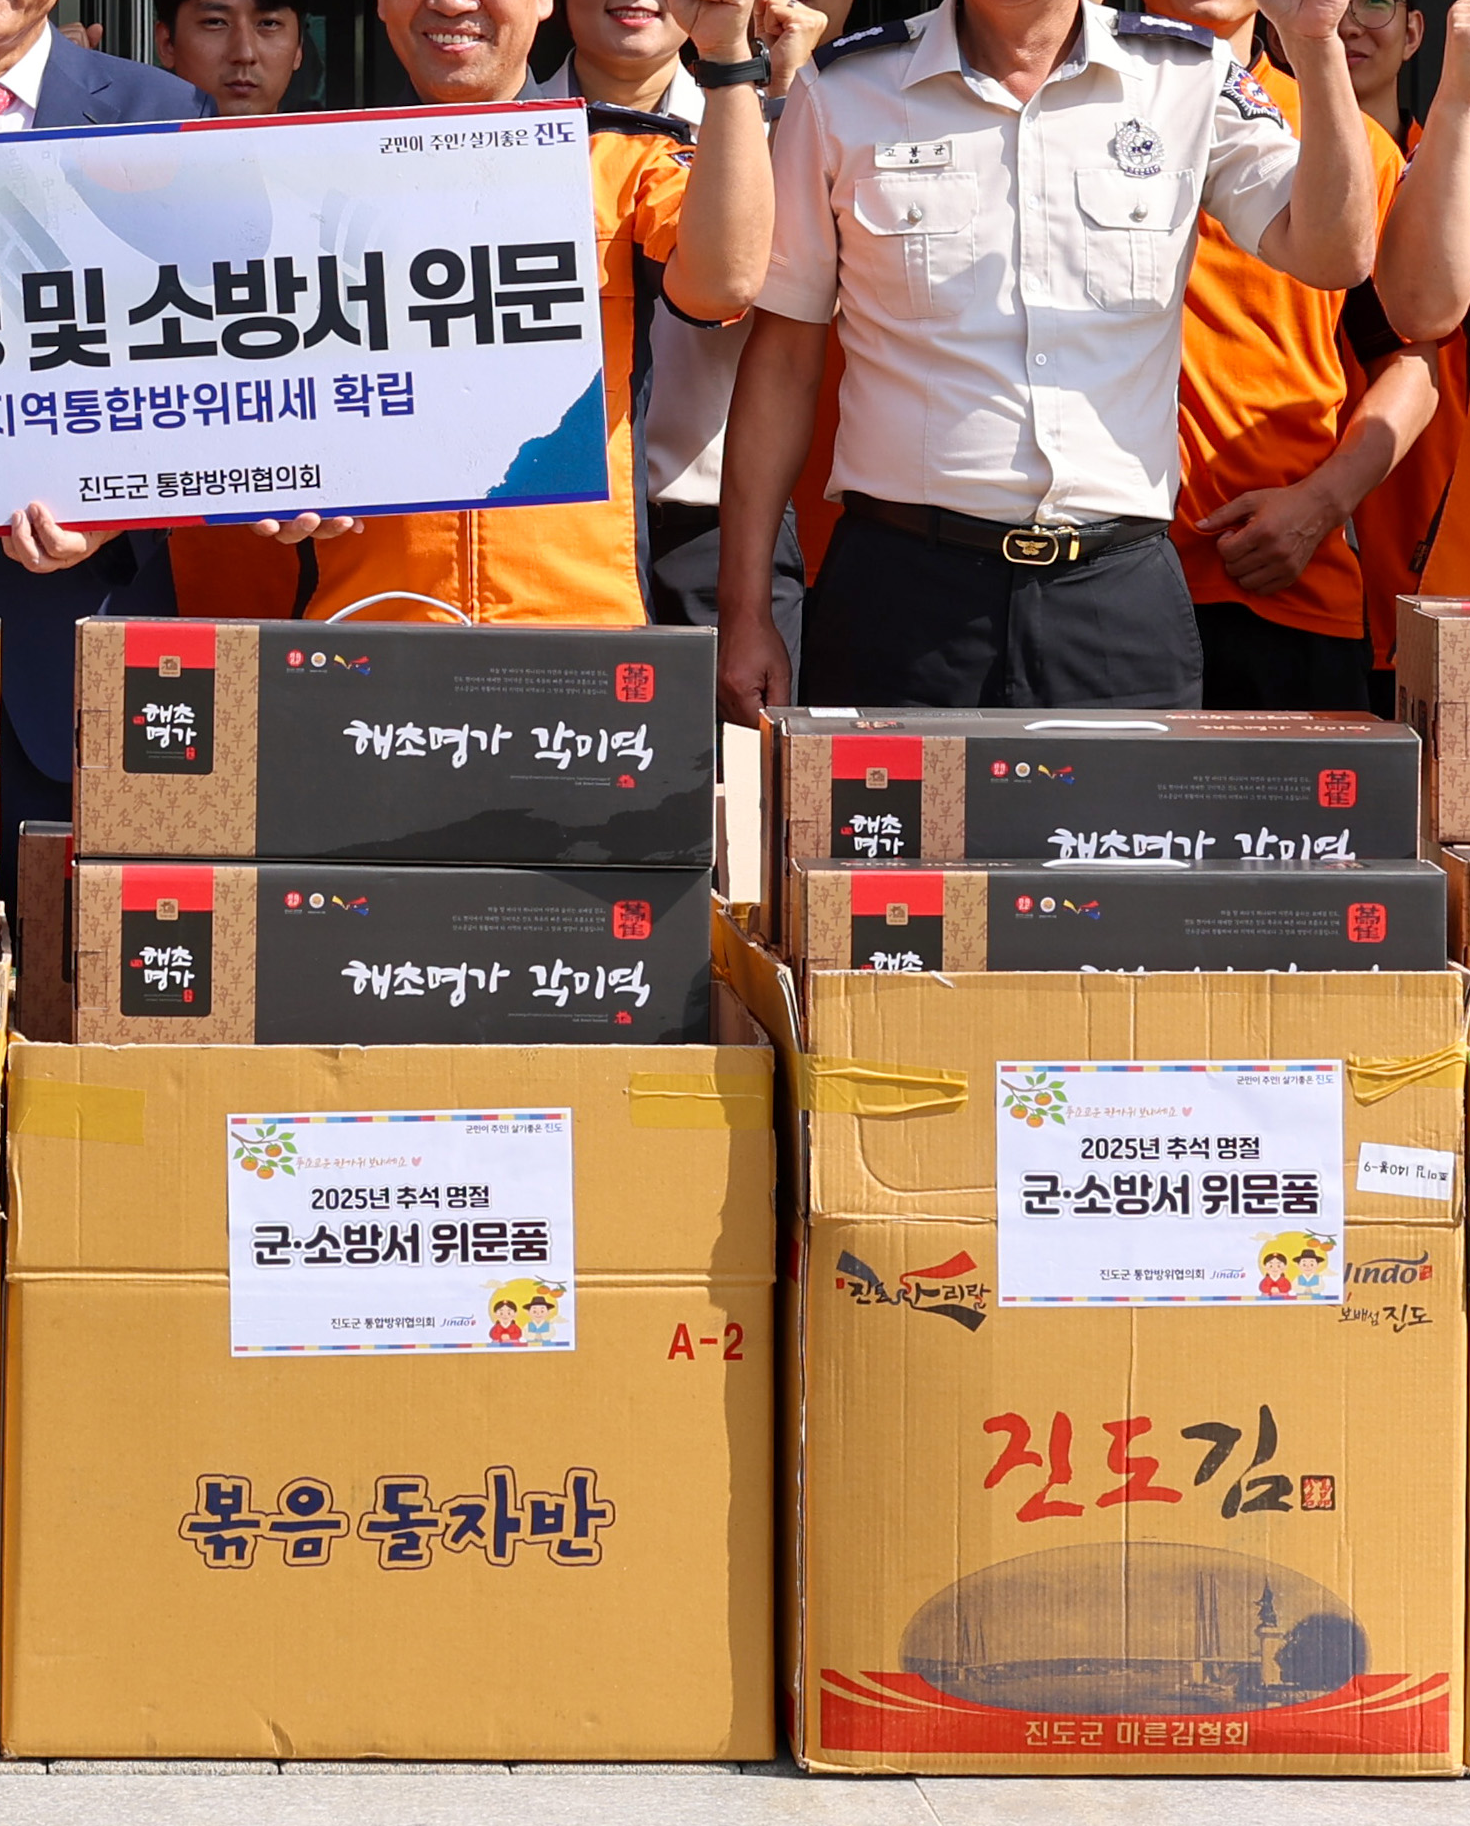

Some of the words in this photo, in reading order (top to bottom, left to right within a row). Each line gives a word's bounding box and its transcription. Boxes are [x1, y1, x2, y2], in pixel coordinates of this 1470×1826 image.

[379, 136, 423, 154] 군민이
[430, 133, 465, 151] 주인!
[469, 129, 529, 149] 살기좋은
[534, 122, 577, 146] 진도
[21, 266, 110, 372] 및
[127, 251, 389, 361] 소방서
[408, 241, 584, 349] 위문
[333, 371, 417, 418] 확립
[77, 471, 151, 503] 진도군
[155, 463, 322, 499] 통합방위협의회
[141, 702, 196, 724] 해초
[145, 723, 198, 749] 명가
[341, 720, 513, 770] 해초명가
[531, 720, 654, 771] 각미역
[849, 813, 903, 835] 해초
[138, 945, 194, 967] 해초
[143, 966, 196, 991] 명가
[340, 960, 511, 1008] 해초명가
[528, 958, 651, 1008] 각미역
[1315, 1074, 1334, 1084] 진도
[1081, 1137, 1160, 1160] 2025년
[1166, 1137, 1210, 1160] 추석
[1217, 1137, 1261, 1160] 명절
[311, 1187, 390, 1210] 2025년
[396, 1186, 440, 1210] 추석
[446, 1186, 490, 1209] 명절
[1023, 1173, 1189, 1215] 군·소방서
[1201, 1174, 1319, 1214] 위문품
[254, 1223, 419, 1265] 군·소방서
[431, 1221, 549, 1263] 위문품
[1099, 1268, 1130, 1281] 진도군
[1133, 1268, 1205, 1281] 통합방위협의회
[330, 1317, 361, 1330] 진도군
[364, 1316, 435, 1329] 통합방위협의회
[1384, 1303, 1433, 1333] 진도
[667, 1322, 745, 1361] A-2
[983, 1404, 1294, 1523] 진도김
[184, 1477, 347, 1565] 볶음
[359, 1469, 612, 1565] 돌자반
[1023, 1721, 1104, 1747] 진도군
[1116, 1719, 1249, 1747] 마른김협회
